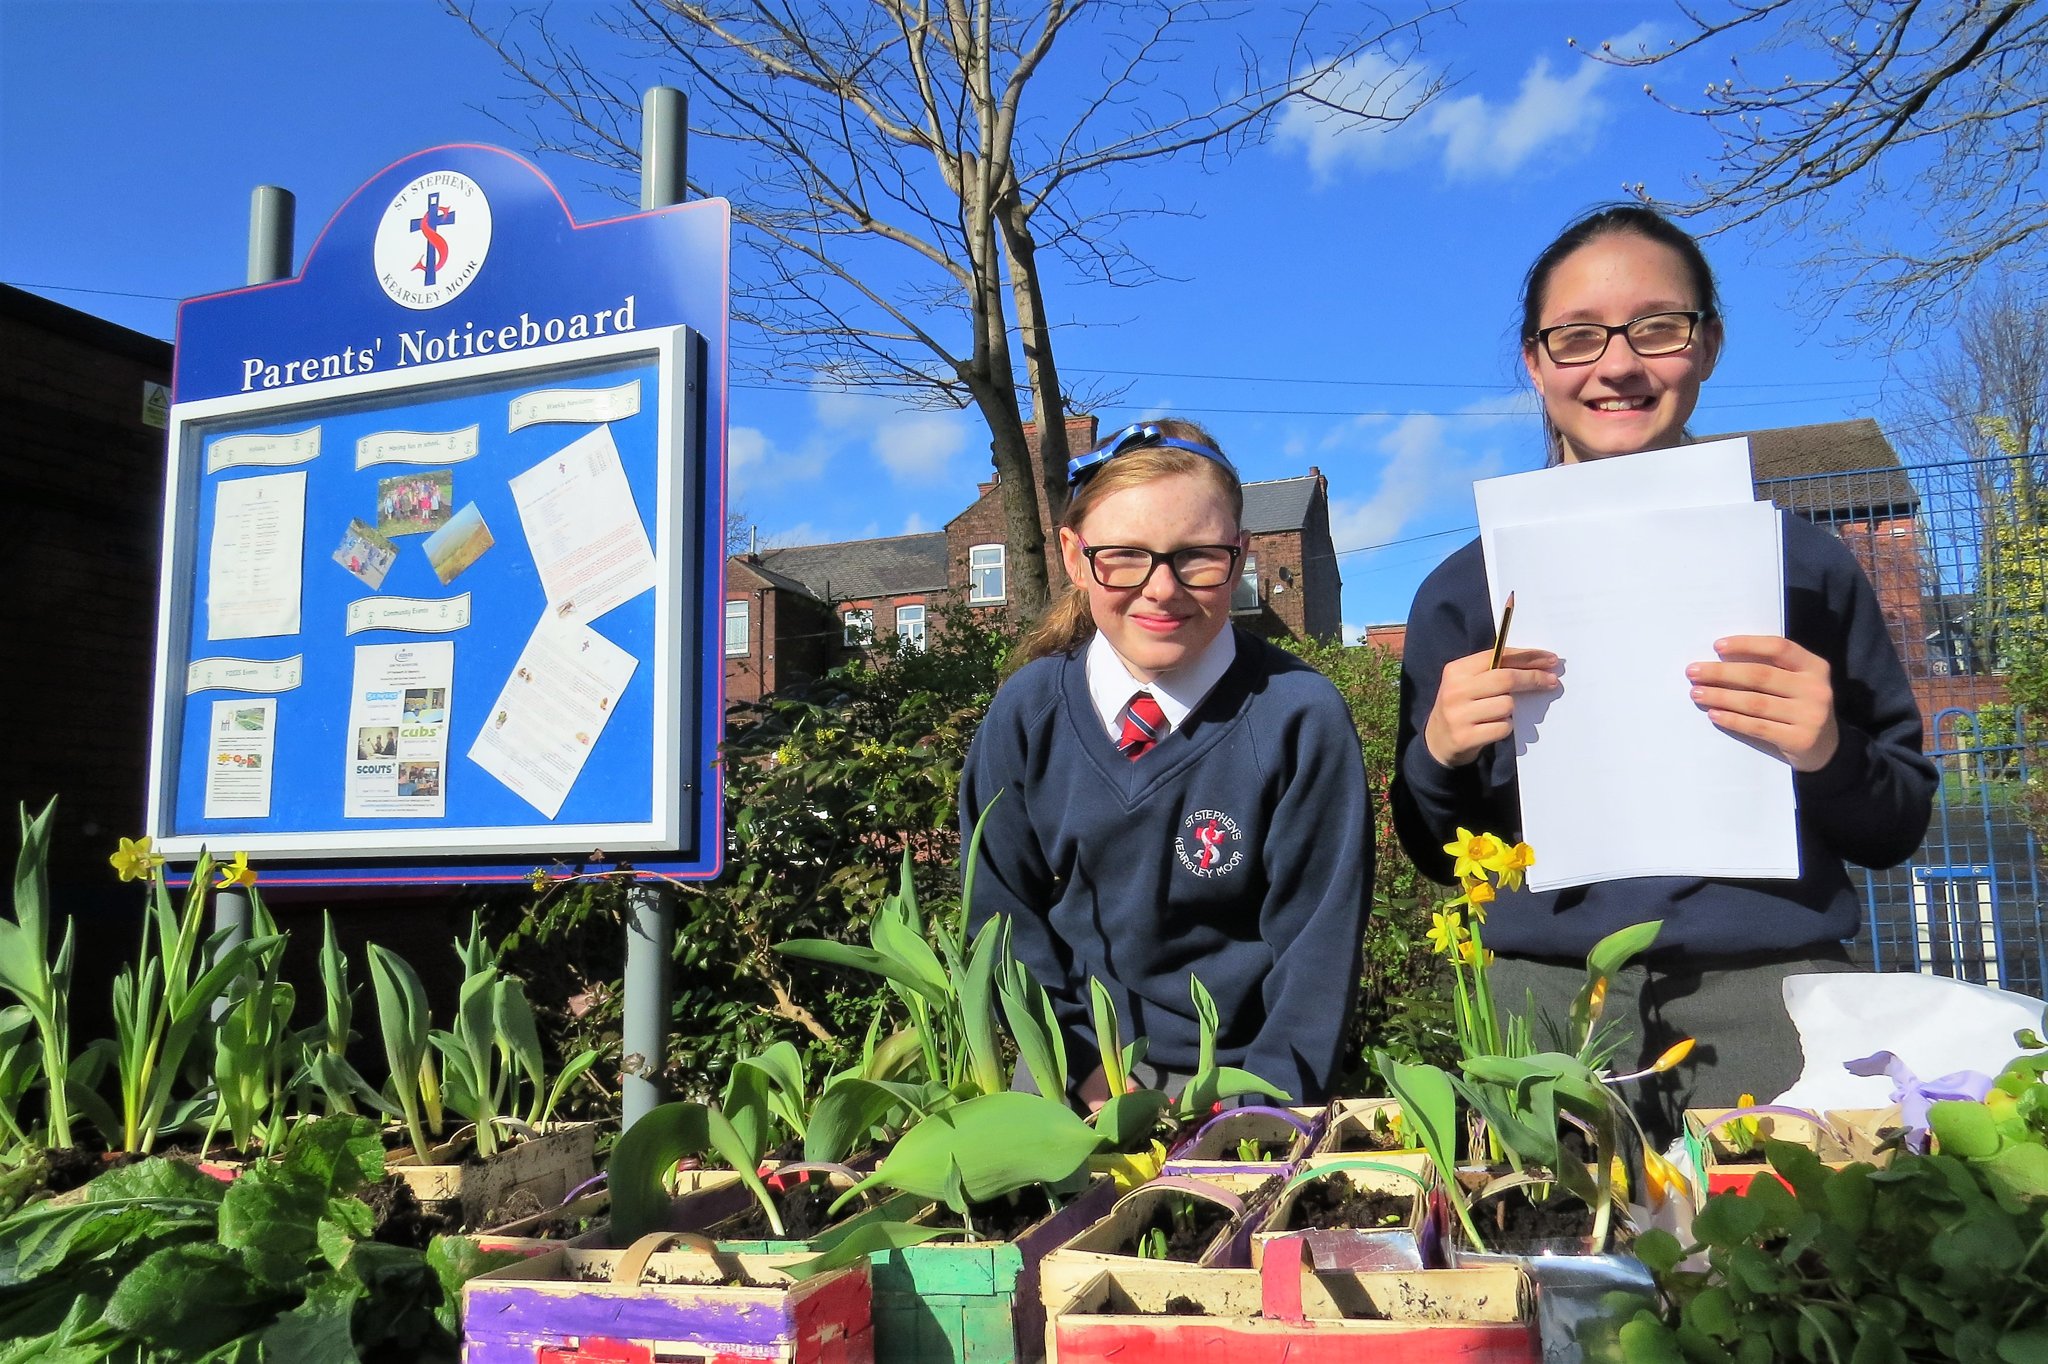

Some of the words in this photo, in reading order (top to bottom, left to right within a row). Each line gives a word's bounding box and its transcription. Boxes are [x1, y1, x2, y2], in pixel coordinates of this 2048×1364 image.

[394, 193, 408, 211] ST
[410, 174, 474, 198] STEPHEN'S
[383, 273, 440, 304] KEARSLEY
[447, 260, 479, 296] MOOR
[241, 338, 383, 391] Parents'
[397, 295, 636, 366] Noticeboard
[400, 726, 437, 738] cubs
[356, 764, 392, 774] SCOUTS
[1184, 814, 1196, 829] ST
[1194, 809, 1243, 841] STEPHEN'S
[1174, 836, 1213, 878] KEARSLEY
[1216, 851, 1244, 877] MOOR
